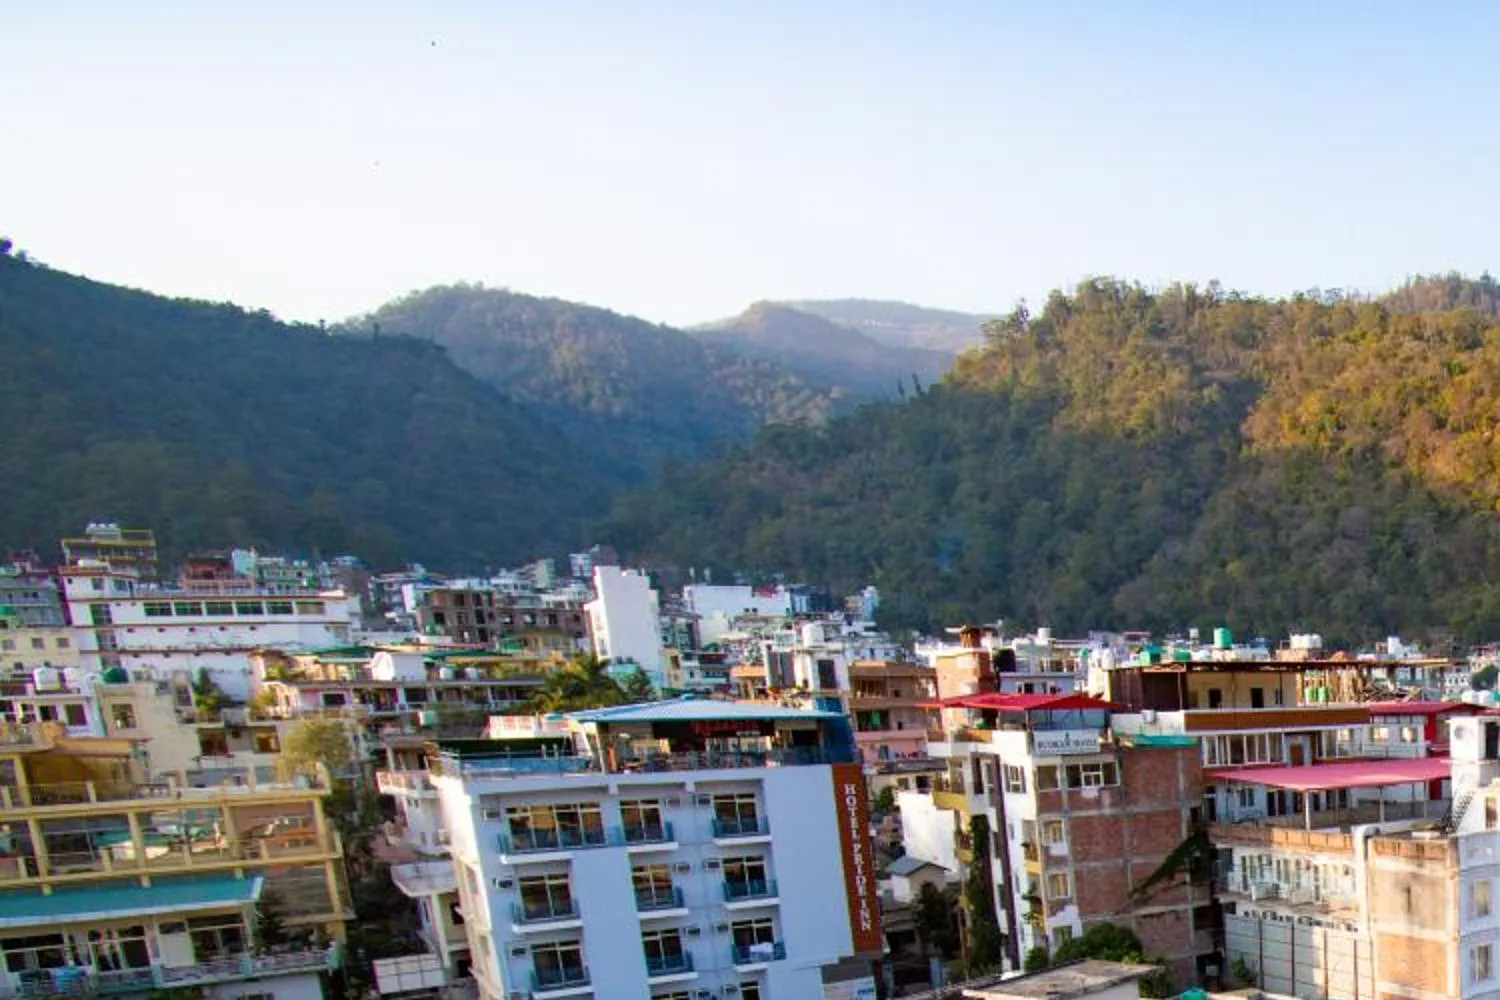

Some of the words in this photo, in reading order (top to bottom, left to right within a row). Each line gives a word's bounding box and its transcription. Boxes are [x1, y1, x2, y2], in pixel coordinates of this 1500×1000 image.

[844, 783, 861, 841] HOTEL
[852, 843, 867, 896] PRIDE
[860, 899, 872, 931] INN
